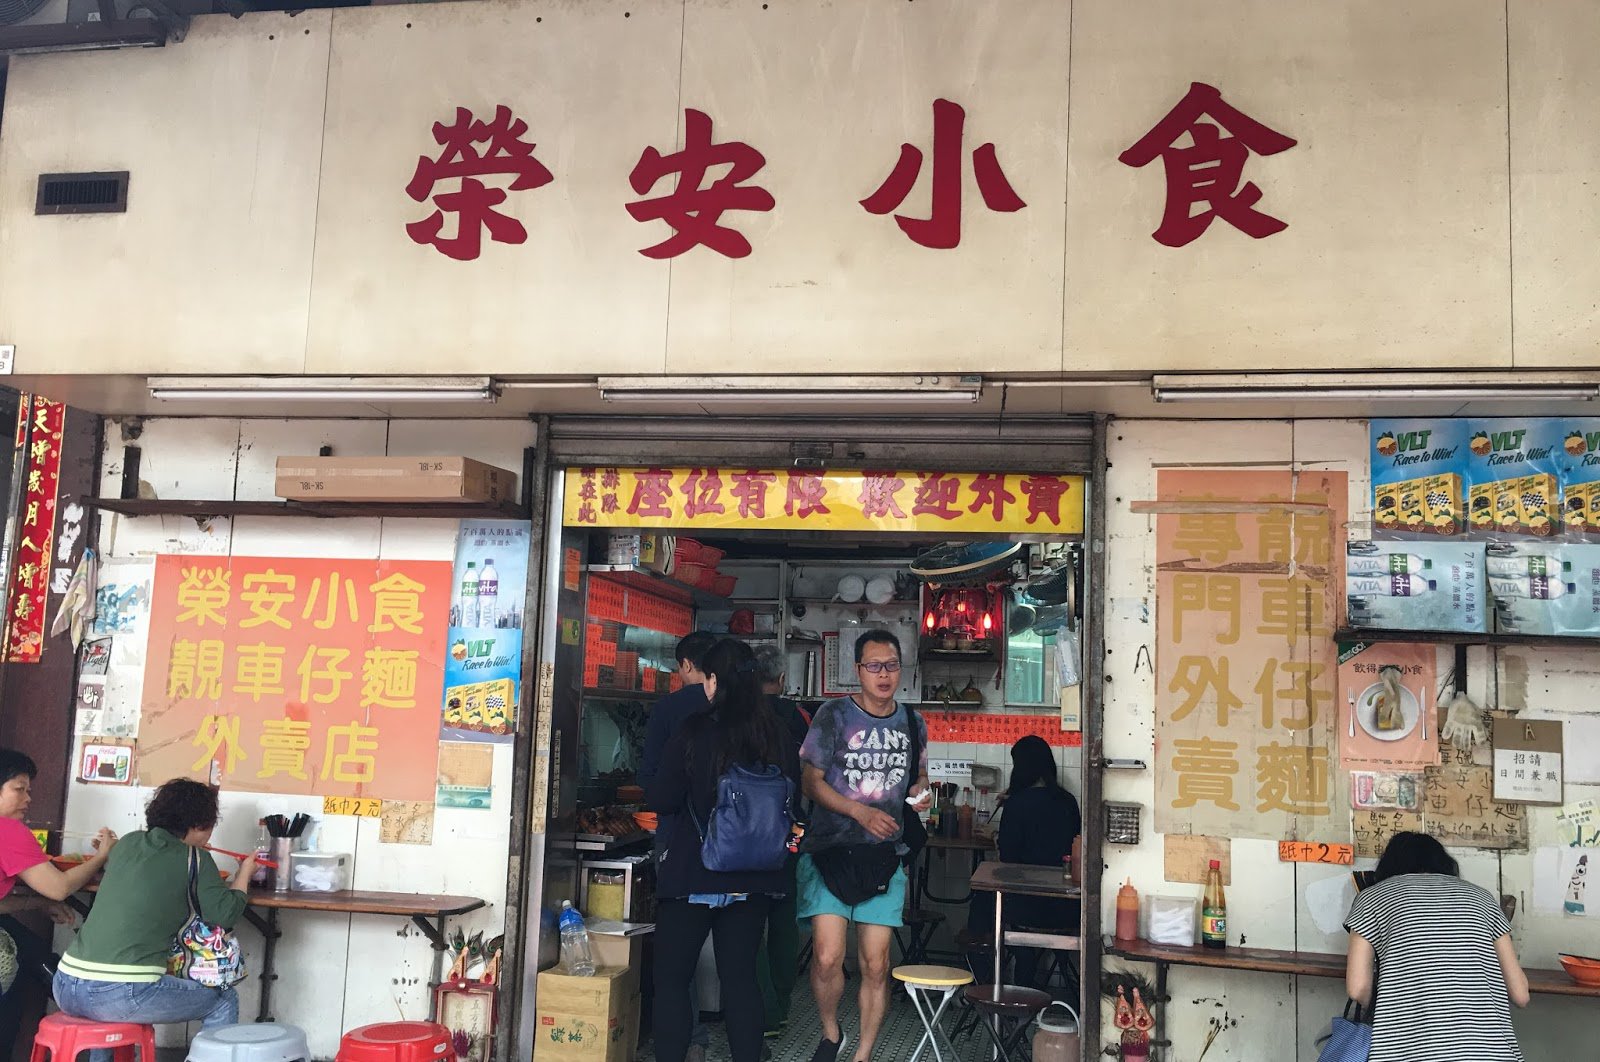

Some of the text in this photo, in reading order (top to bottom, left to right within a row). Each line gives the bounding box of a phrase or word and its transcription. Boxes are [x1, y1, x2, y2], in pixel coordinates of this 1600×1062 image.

[406, 82, 1297, 260] 榮安小食
[1397, 430, 1432, 453] VLT
[1491, 429, 1526, 452] VLT
[1392, 445, 1459, 467] Race to Win!
[1487, 444, 1554, 467] Race to Win!
[626, 467, 831, 520] 座位有限
[175, 564, 426, 635] 榮安小食
[466, 638, 496, 659] VLT
[1168, 492, 1243, 812] 專門外賣
[166, 639, 418, 708] 靚車仔麵
[462, 654, 515, 672] Race to Win!
[1353, 663, 1423, 676] 飲得小食
[191, 713, 380, 783] 外賣店
[1513, 752, 1542, 767] 招請
[1500, 768, 1558, 783] 日間兼職
[1280, 842, 1352, 864] 紙巾2元
